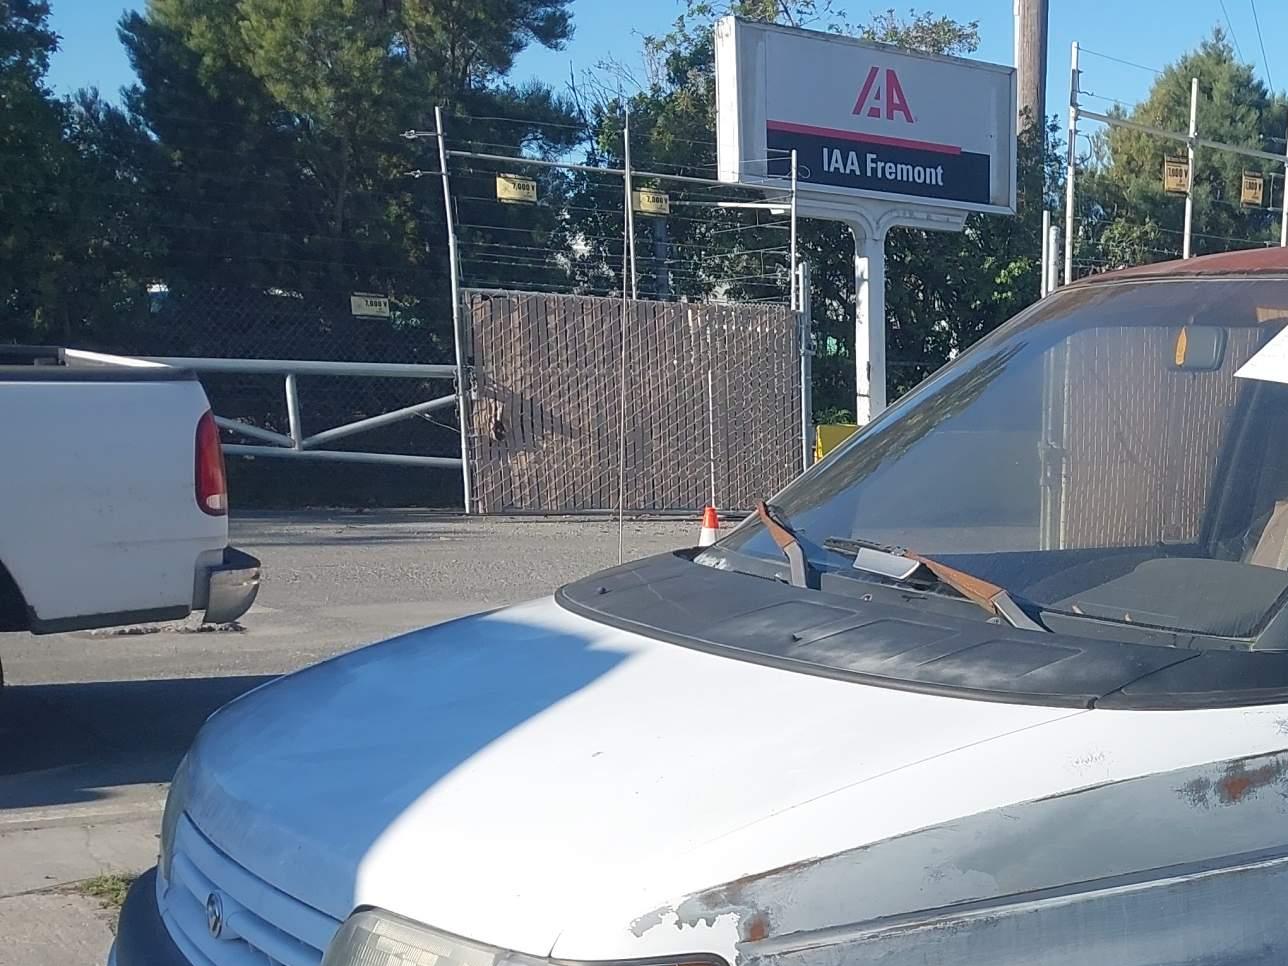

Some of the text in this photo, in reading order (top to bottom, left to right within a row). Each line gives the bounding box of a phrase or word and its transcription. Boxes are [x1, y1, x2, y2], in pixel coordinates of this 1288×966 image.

[822, 147, 944, 187] IAA Fremont
[512, 182, 530, 191] 7,000
